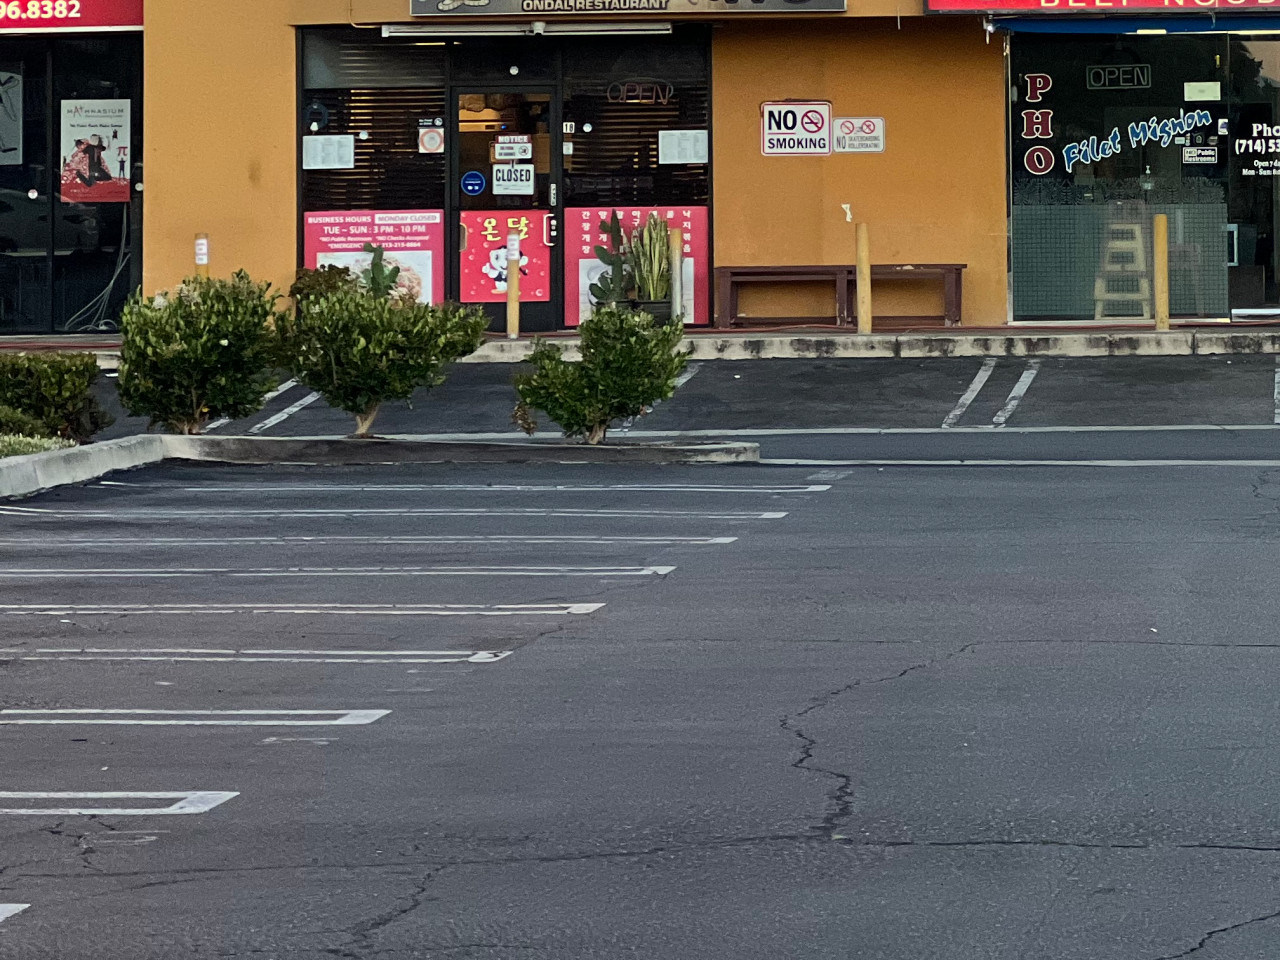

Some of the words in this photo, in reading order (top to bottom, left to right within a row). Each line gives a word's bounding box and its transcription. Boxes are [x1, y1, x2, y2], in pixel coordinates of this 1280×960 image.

[1089, 66, 1148, 87] OPEN
[607, 82, 670, 105] OPEN
[768, 110, 797, 131] NO
[1021, 73, 1055, 175] PHO
[498, 135, 529, 143] NOTICE
[767, 138, 827, 149] SMOKING
[836, 135, 847, 149] NO
[1062, 127, 1121, 173] Filet
[1128, 108, 1212, 148] Mignon
[1235, 139, 1266, 154] (714)
[495, 169, 531, 182] CLOSED
[308, 216, 344, 224] BUSINESS
[323, 226, 340, 234] TUE
[349, 225, 367, 234] SUN
[380, 225, 394, 233] PM
[412, 224, 426, 232] PM
